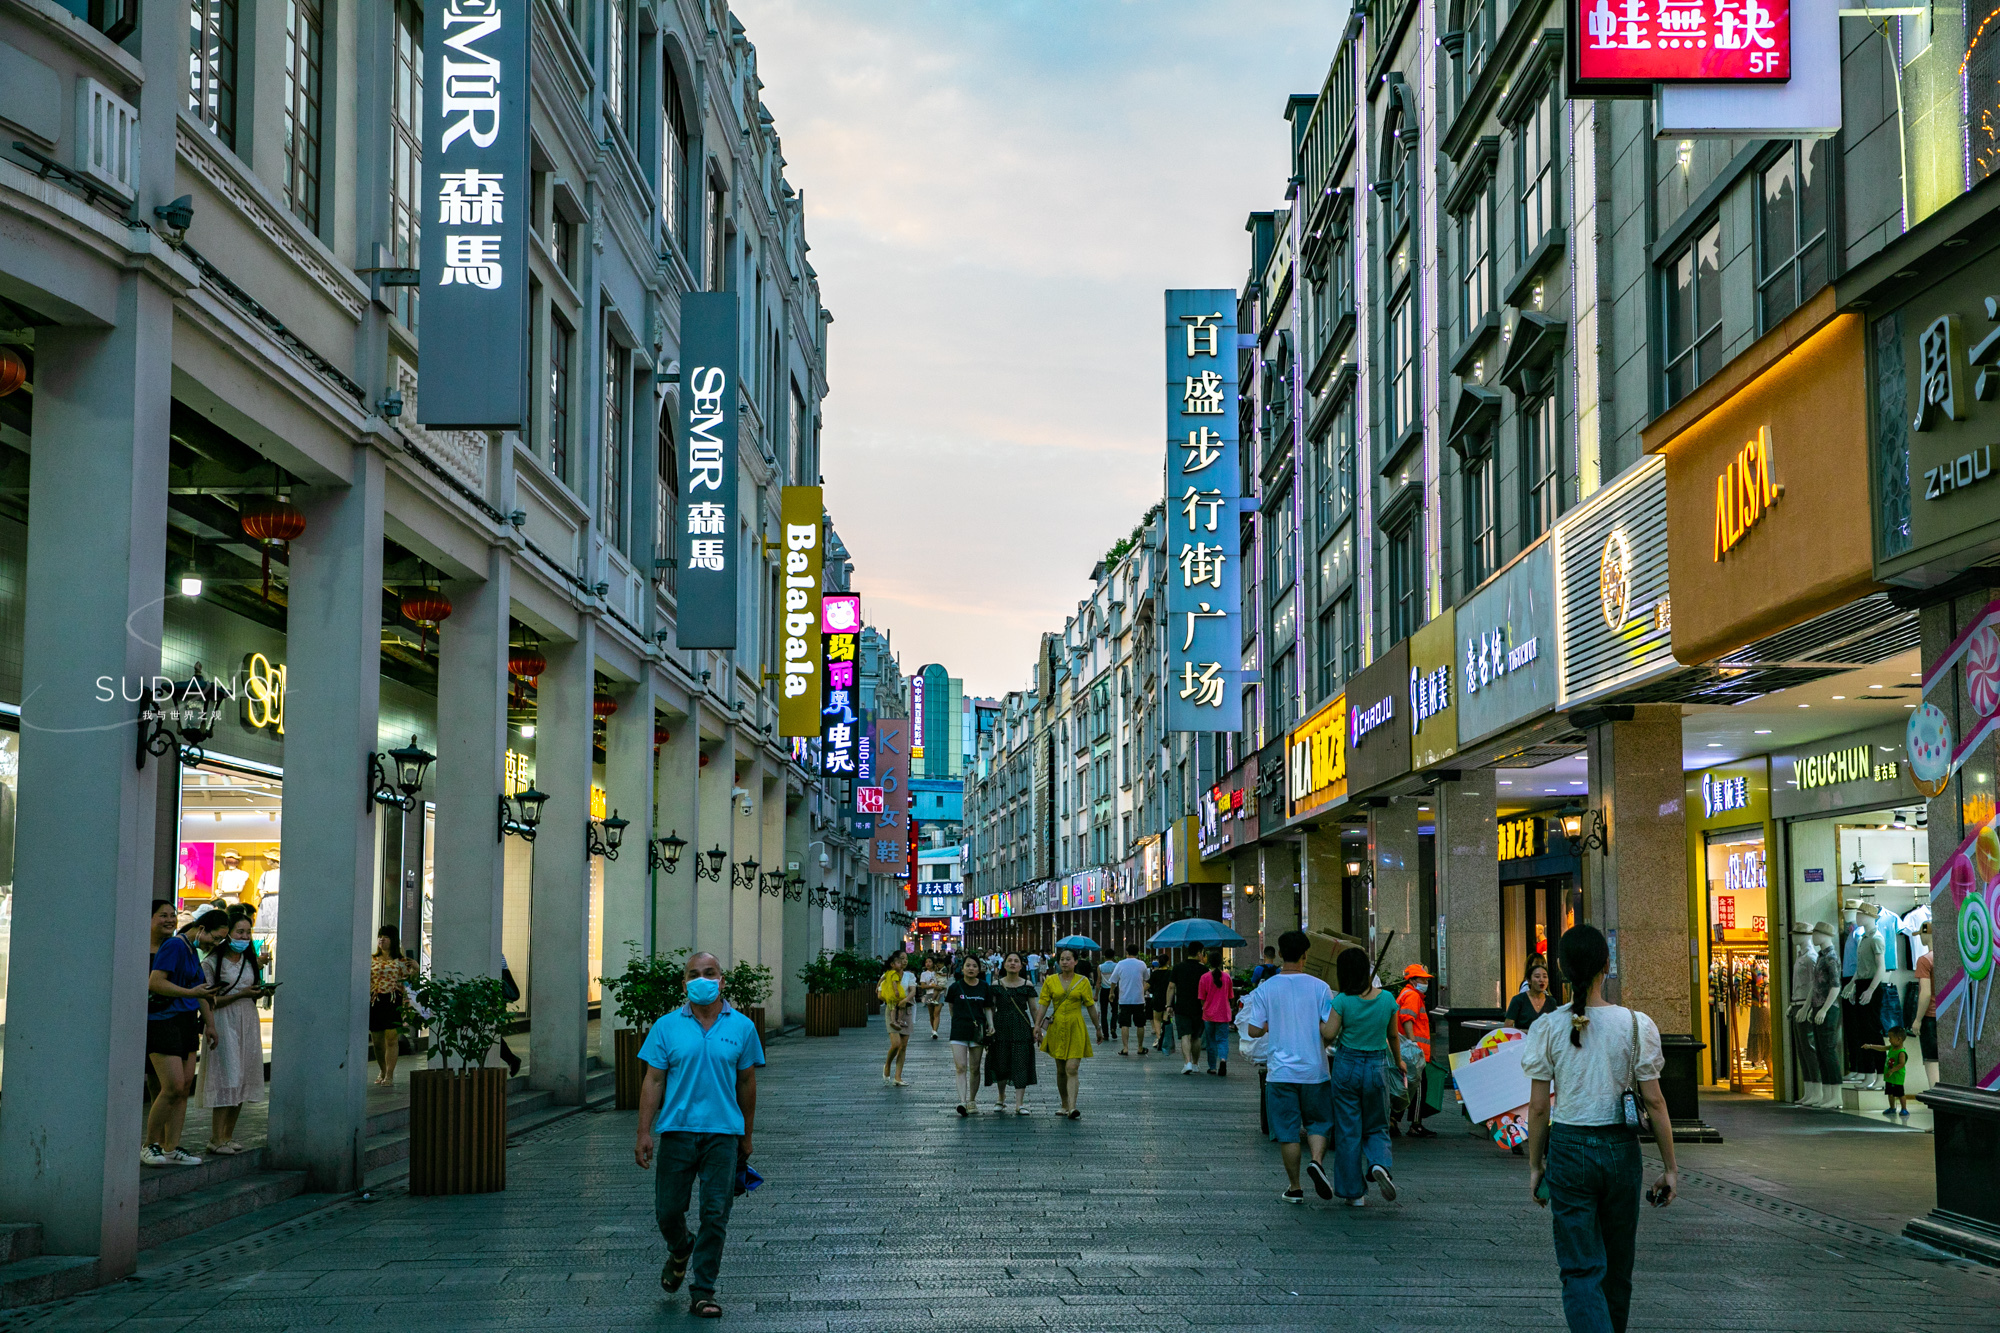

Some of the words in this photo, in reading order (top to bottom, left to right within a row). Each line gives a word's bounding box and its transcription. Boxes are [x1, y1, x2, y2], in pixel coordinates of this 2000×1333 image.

[1749, 51, 1780, 74] 5F
[438, 168, 505, 290] 森馬
[689, 366, 726, 494] SEMIR
[1924, 444, 1991, 501] ZHOU
[687, 501, 726, 571] 森馬
[1179, 310, 1227, 709] 百盛步行街广场
[785, 523, 816, 699] Balabala
[823, 634, 857, 773] 玛丽奥电玩
[1359, 695, 1392, 736] CHAOJU
[1418, 664, 1448, 720] 集依美
[858, 736, 870, 779] NUO-KU
[1292, 736, 1312, 802] HLA
[1793, 745, 1870, 791] YIGUCHUN
[1873, 762, 1898, 782] 意古纯
[1713, 776, 1747, 812] 集依美
